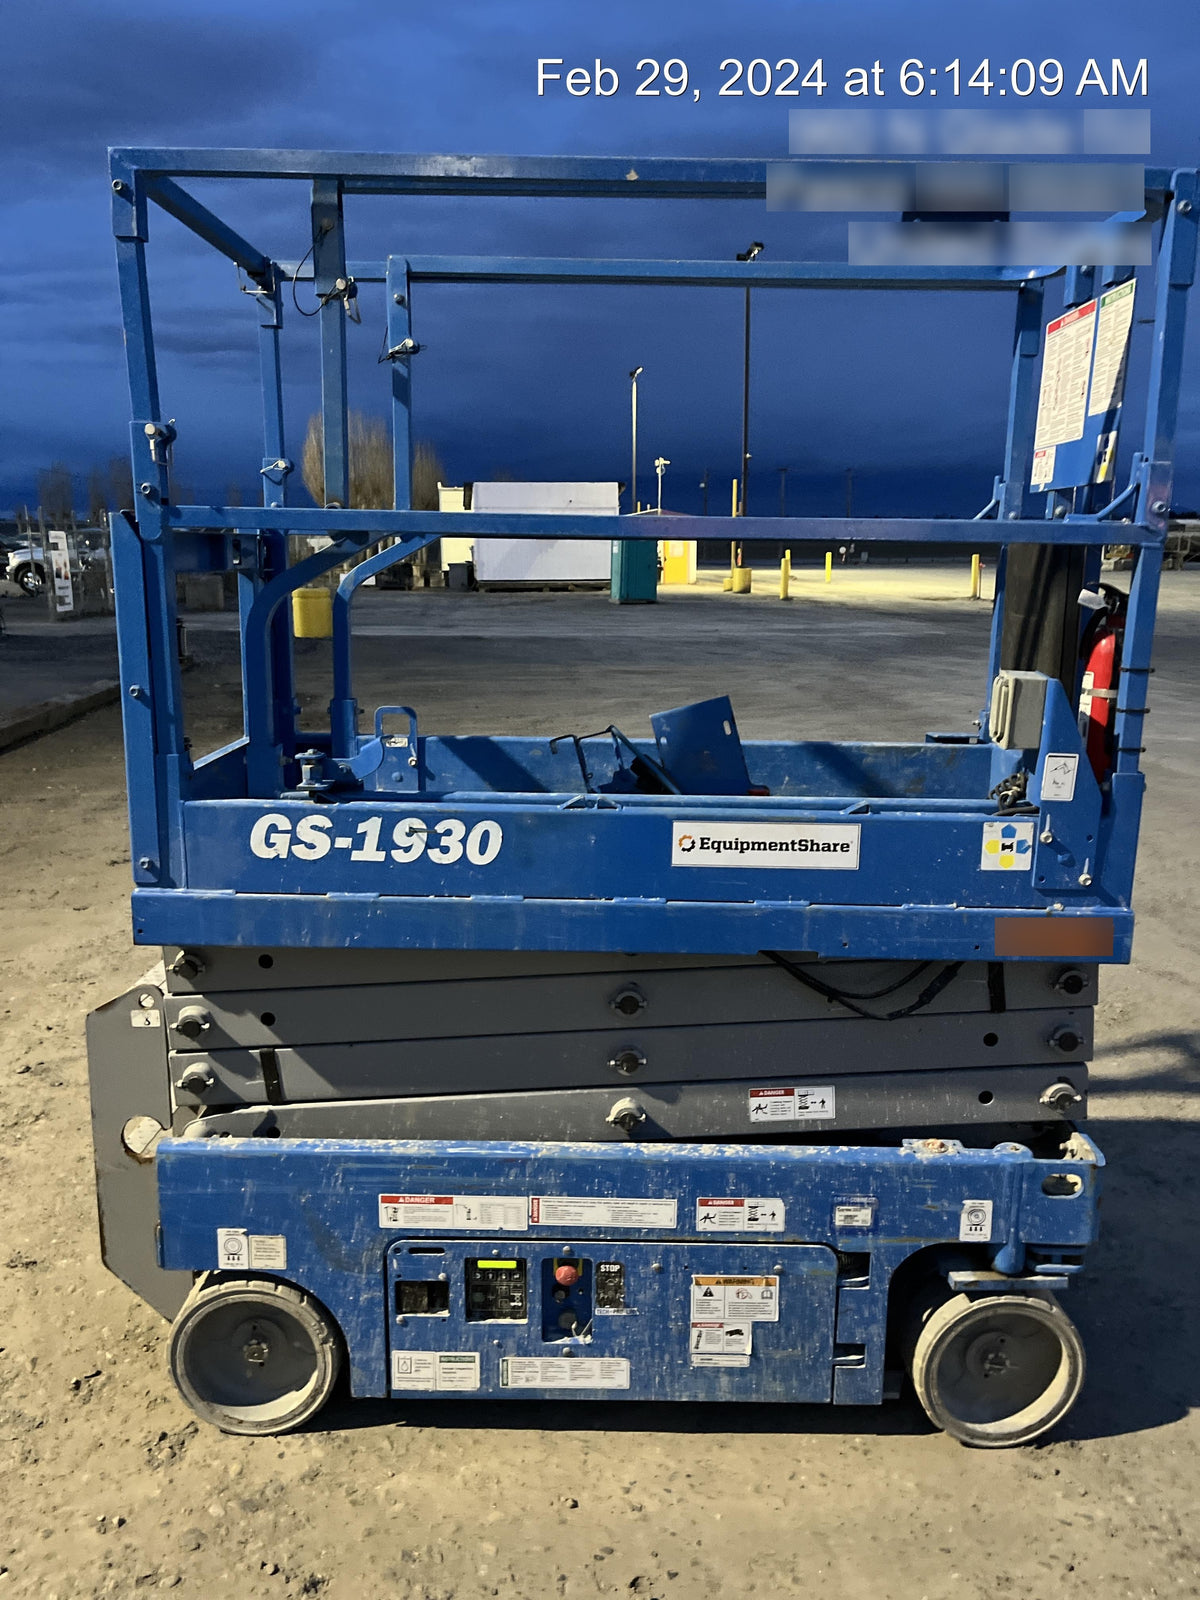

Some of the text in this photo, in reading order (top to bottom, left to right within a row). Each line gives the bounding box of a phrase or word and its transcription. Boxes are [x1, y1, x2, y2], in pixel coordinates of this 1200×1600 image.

[250, 813, 503, 866] GS-1930
[699, 837, 851, 853] EquipmentShare
[404, 1196, 435, 1204] DANGER
[600, 1264, 621, 1272] STOP
